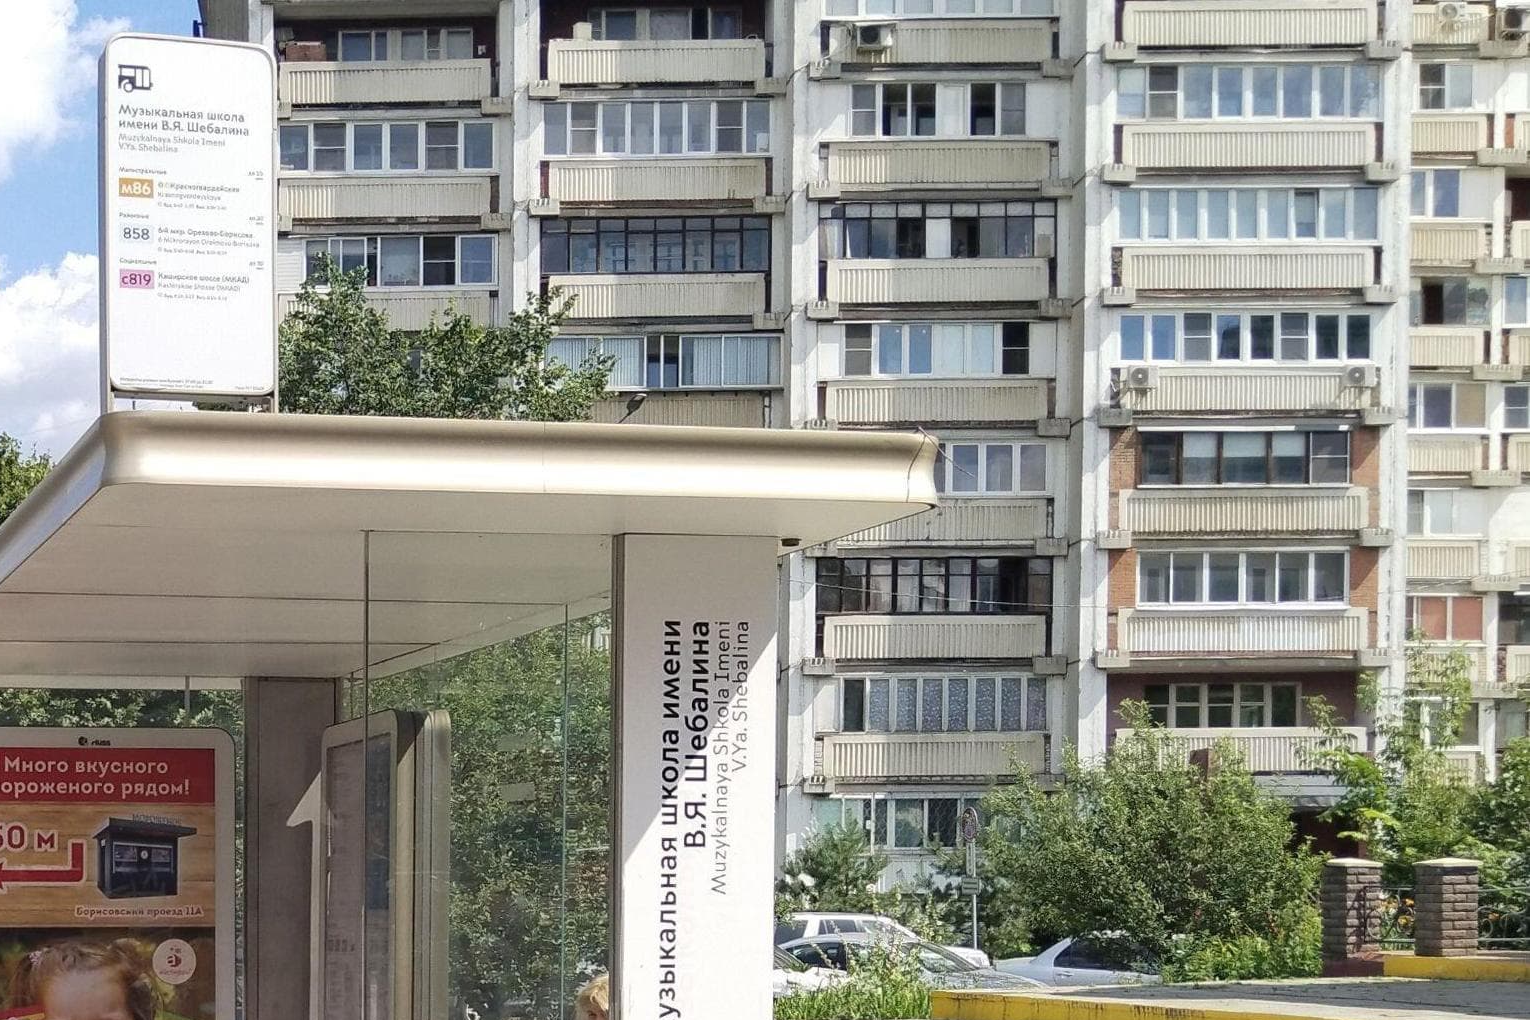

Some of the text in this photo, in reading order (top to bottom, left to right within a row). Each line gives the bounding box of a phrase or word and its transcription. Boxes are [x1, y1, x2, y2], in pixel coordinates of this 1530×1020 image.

[118, 104, 245, 123] Музыкальная школа
[118, 119, 250, 136] имени В.Я. Шебалина
[120, 181, 152, 196] м86
[123, 226, 150, 241] 858
[121, 272, 152, 286] с819
[662, 620, 682, 719] имени
[731, 620, 750, 773] V.Ya. Shebalina
[683, 620, 710, 848] В.Я. Шебалина
[3, 755, 168, 778] Много вкусного
[710, 620, 732, 895] Muzykalnaya Shkola Imeni
[661, 729, 680, 825] школа
[121, 779, 190, 799] рядом!
[36, 831, 57, 850] м
